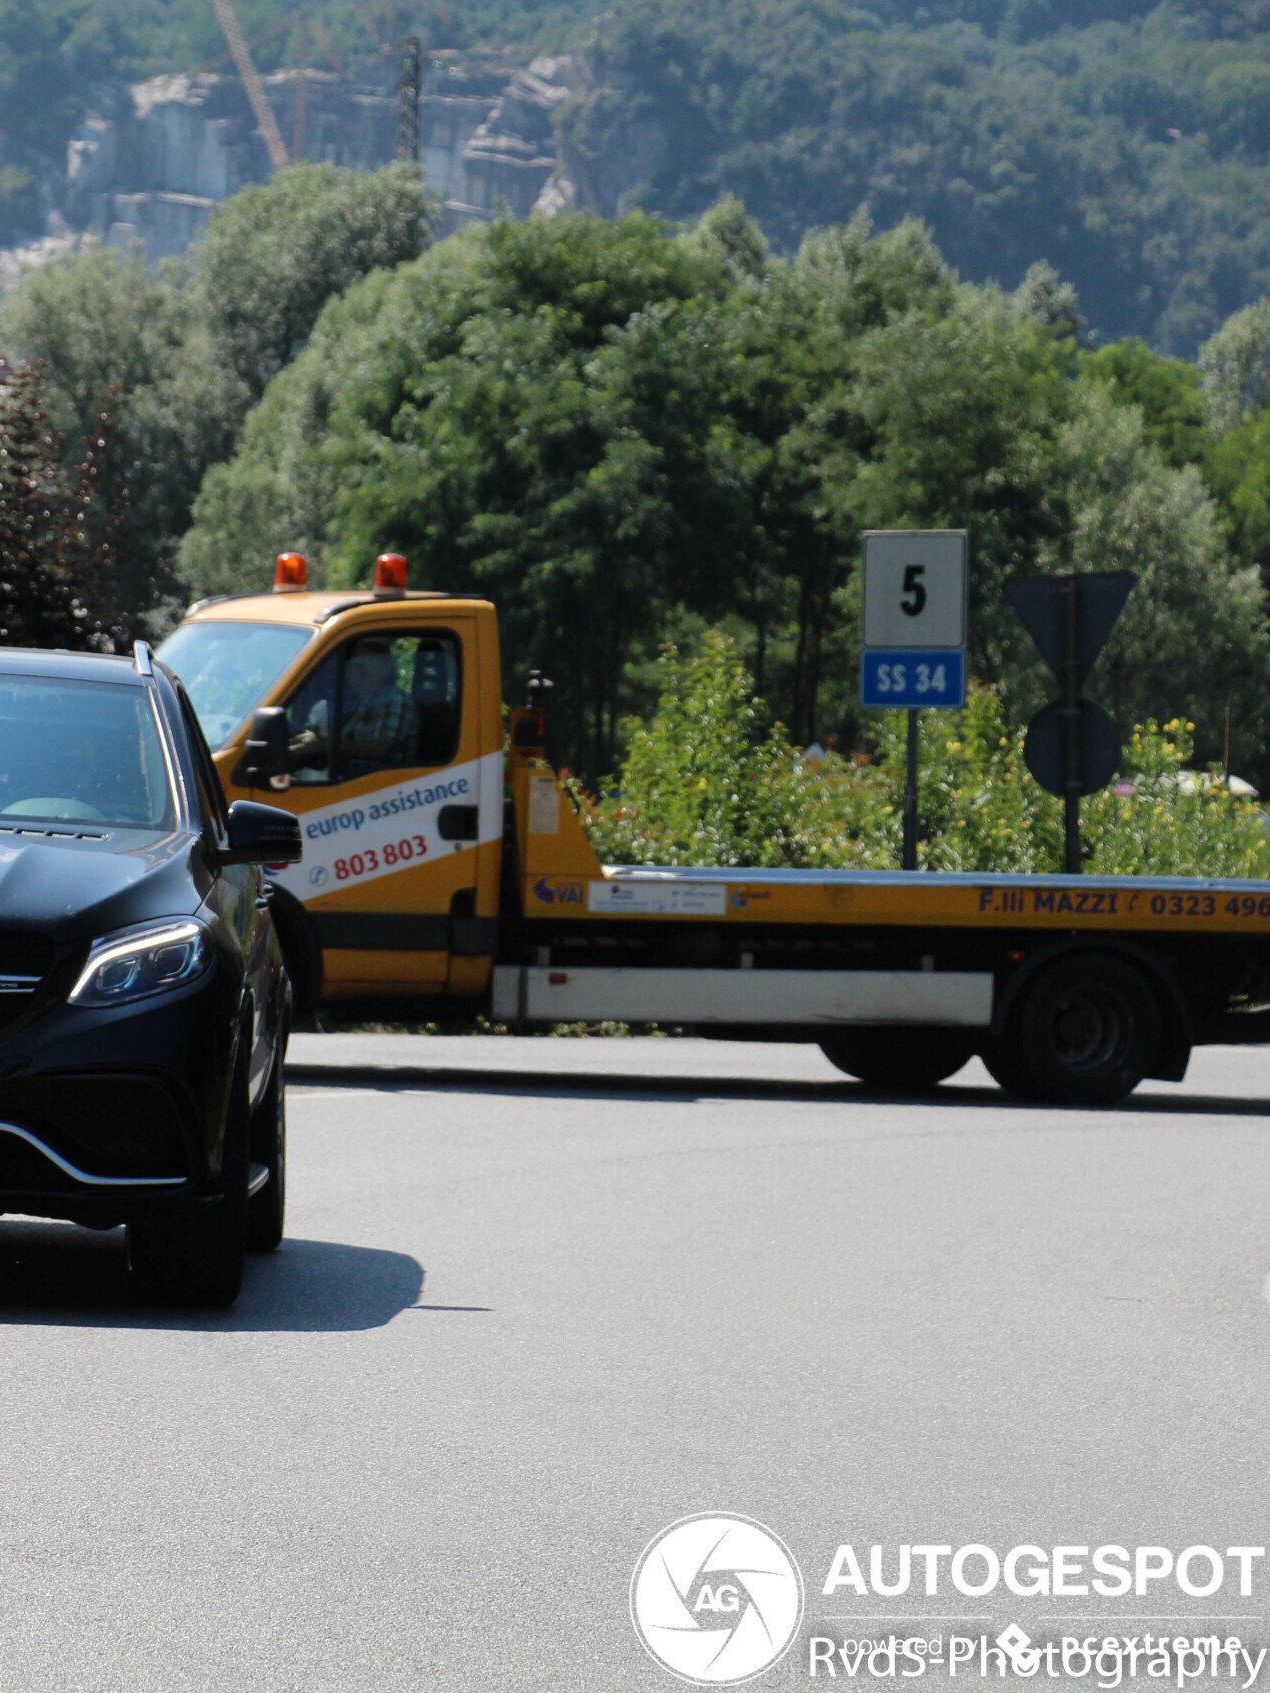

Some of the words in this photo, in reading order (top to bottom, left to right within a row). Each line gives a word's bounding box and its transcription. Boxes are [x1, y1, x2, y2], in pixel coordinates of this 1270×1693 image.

[901, 564, 927, 617] 5
[876, 664, 907, 692] SS
[915, 664, 947, 693] 34
[306, 808, 365, 839] europ
[369, 777, 470, 821] assistance
[334, 849, 380, 881] 803
[382, 834, 428, 865] 803
[1034, 891, 1119, 915] MAZZI
[1151, 894, 1217, 917] 0323
[1224, 896, 1270, 918] 496
